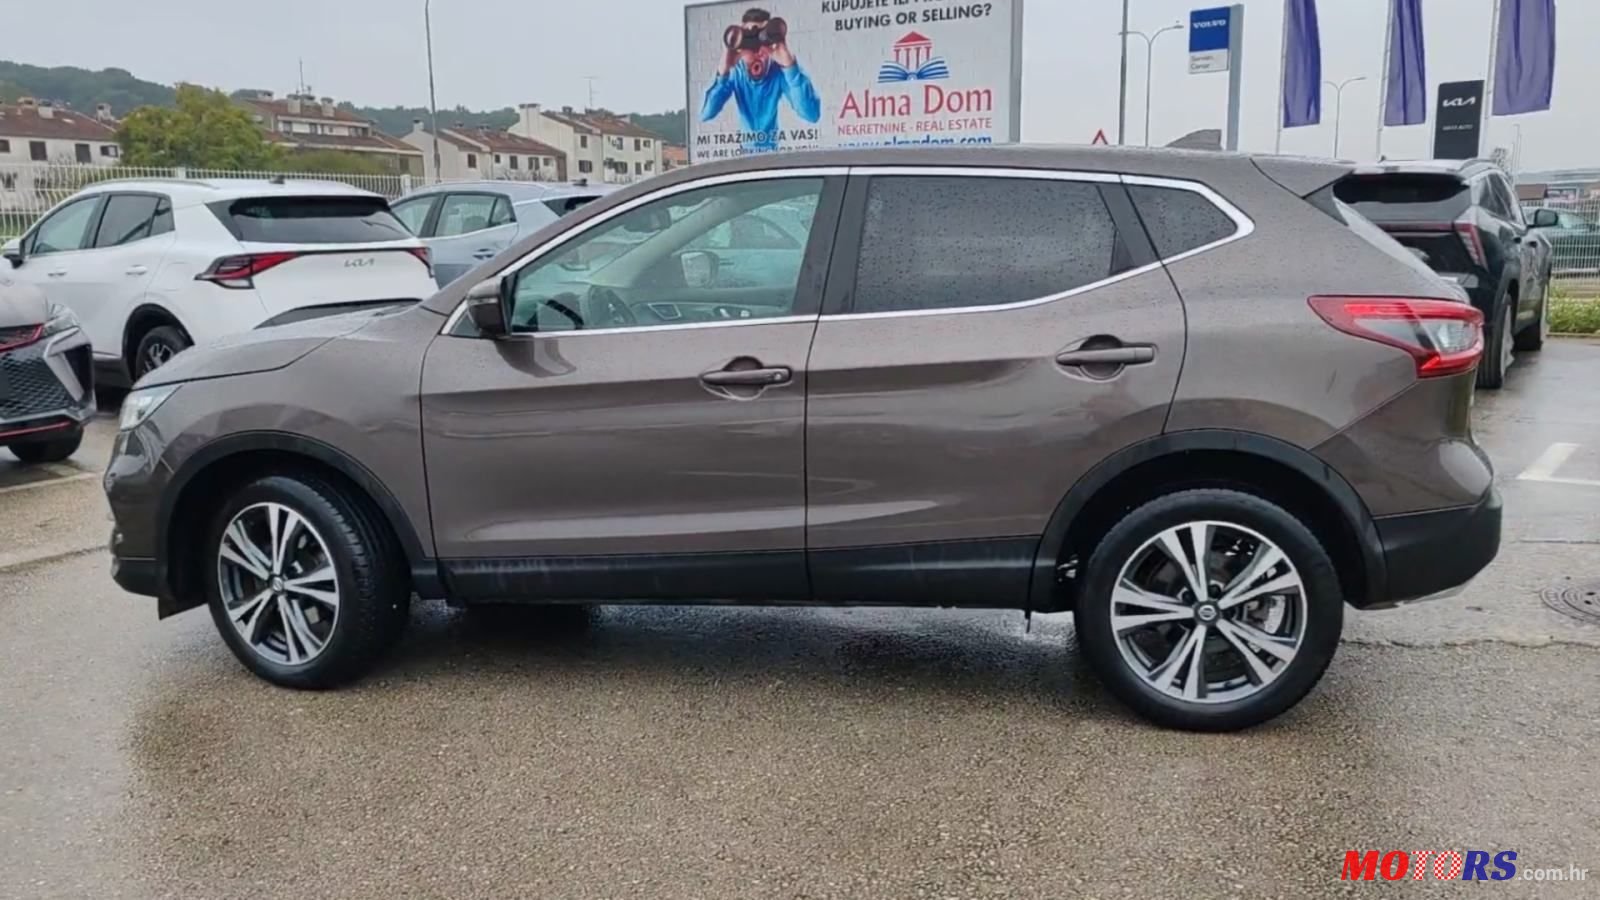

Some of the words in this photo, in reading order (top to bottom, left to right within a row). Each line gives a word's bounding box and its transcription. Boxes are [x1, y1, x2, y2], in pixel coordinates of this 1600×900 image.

[835, 14, 890, 31] BUYING
[895, 11, 917, 25] OR
[922, 3, 992, 22] SELLING?
[1192, 19, 1227, 29] VOLVO
[839, 89, 911, 118] Alma
[924, 84, 992, 114] Dom
[838, 122, 906, 135] NEKRETNINE
[916, 120, 945, 132] REAL
[948, 117, 992, 130] ESTATE
[697, 135, 710, 145] MI
[771, 130, 786, 142] ZA
[791, 129, 818, 140] VAS!
[697, 149, 710, 158] WE
[713, 148, 729, 158] ARE
